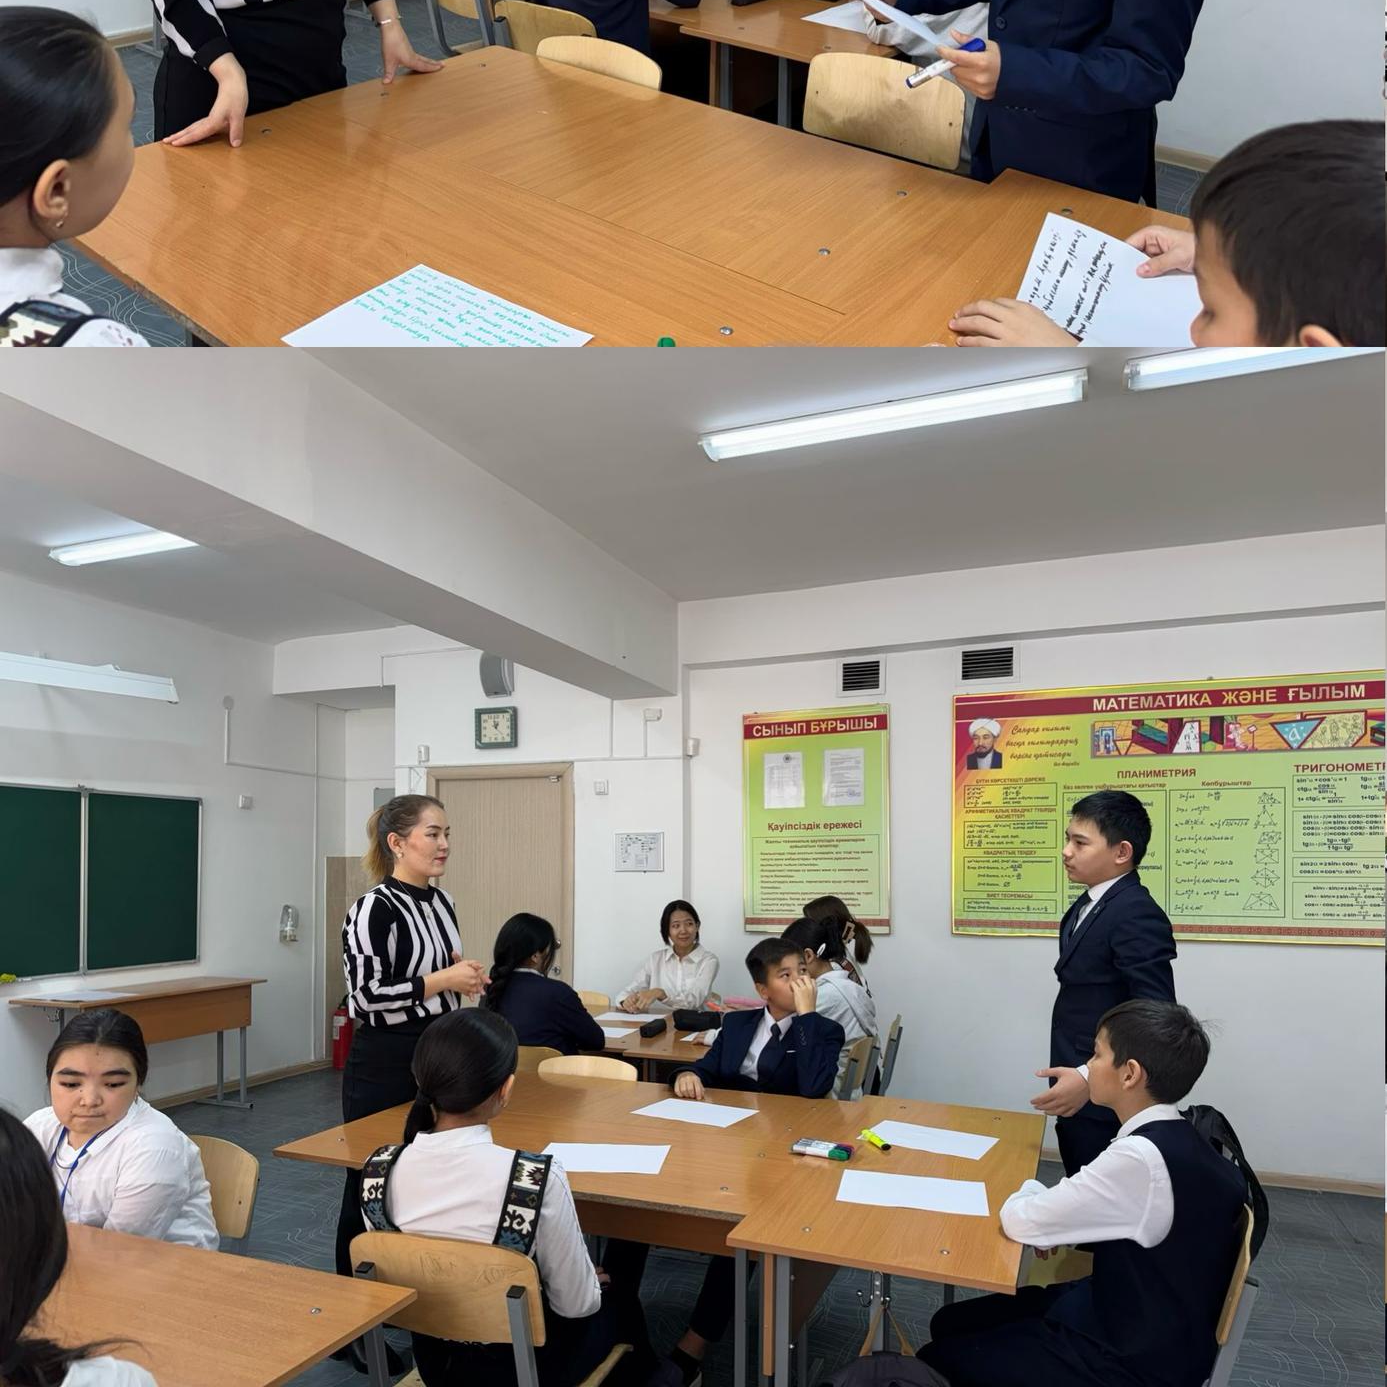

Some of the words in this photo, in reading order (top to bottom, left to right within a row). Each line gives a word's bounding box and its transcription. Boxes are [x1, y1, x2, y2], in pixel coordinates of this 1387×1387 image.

[1092, 693, 1213, 712] МАТЕМАТИКА
[1222, 687, 1278, 705] ЖӘНЕ
[1288, 683, 1366, 701] ҒЫЛЫМ
[752, 722, 807, 738] СЫНЫП
[810, 717, 878, 734] БҰРЫШЫ
[1116, 768, 1197, 779] ПЛАНИМЕТРИЯ
[767, 821, 821, 833] Қауіпсіздік
[822, 819, 862, 831] ережесі
